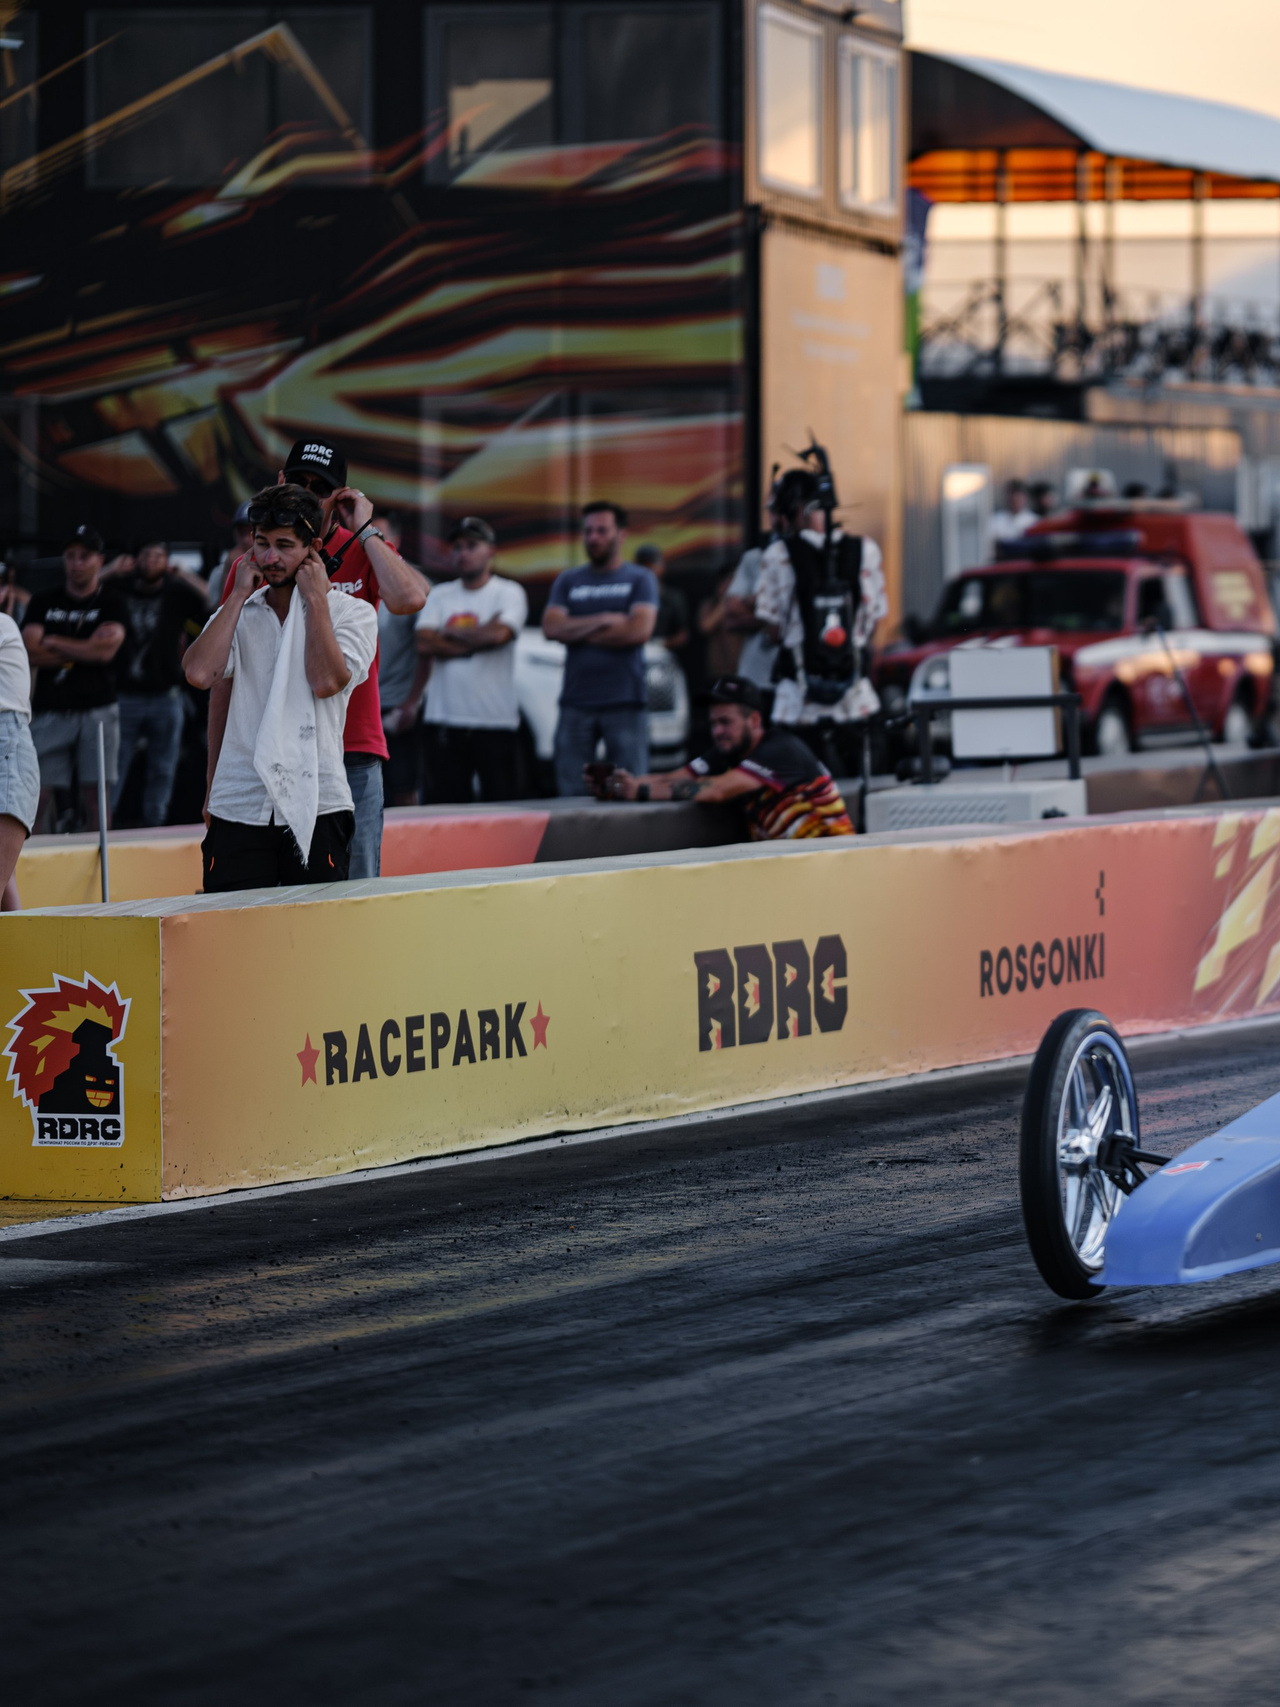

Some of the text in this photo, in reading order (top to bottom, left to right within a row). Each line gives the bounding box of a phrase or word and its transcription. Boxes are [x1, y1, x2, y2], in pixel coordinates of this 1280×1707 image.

[301, 453, 331, 467] Official
[303, 444, 334, 459] RDRC
[980, 932, 1105, 998] ROSGONKI
[693, 933, 848, 1053] RDRC
[322, 1001, 528, 1086] RACEPARK
[37, 1117, 121, 1141] RDRC
